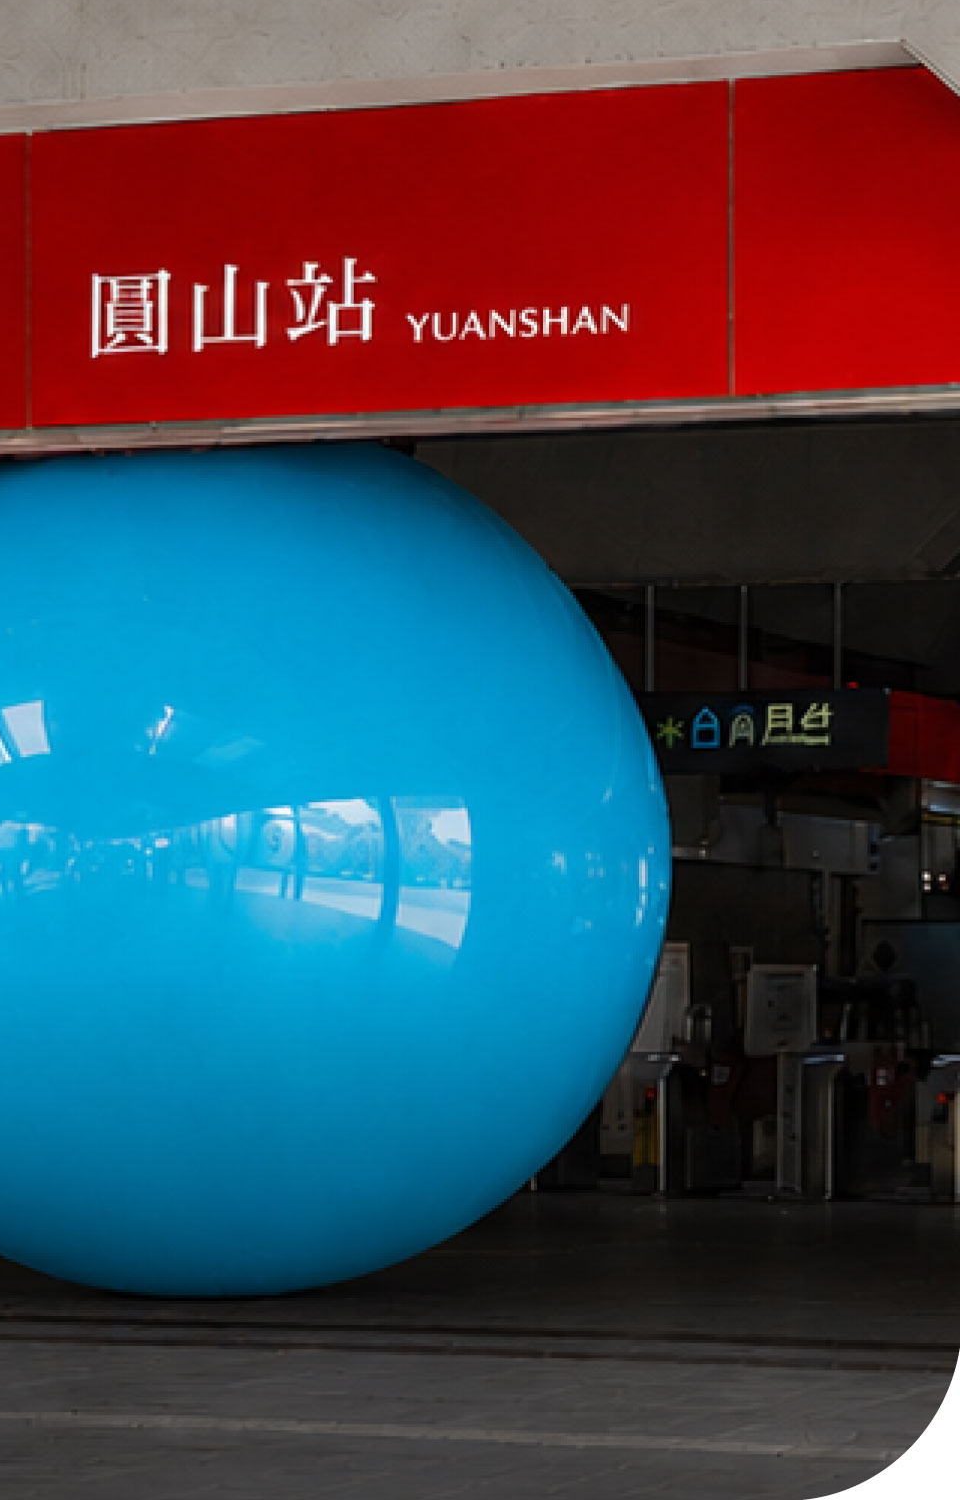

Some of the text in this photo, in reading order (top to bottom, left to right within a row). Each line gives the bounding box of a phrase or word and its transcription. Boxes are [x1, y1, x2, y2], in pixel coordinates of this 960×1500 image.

[91, 257, 630, 358] 圓山站 YUANSHAN
